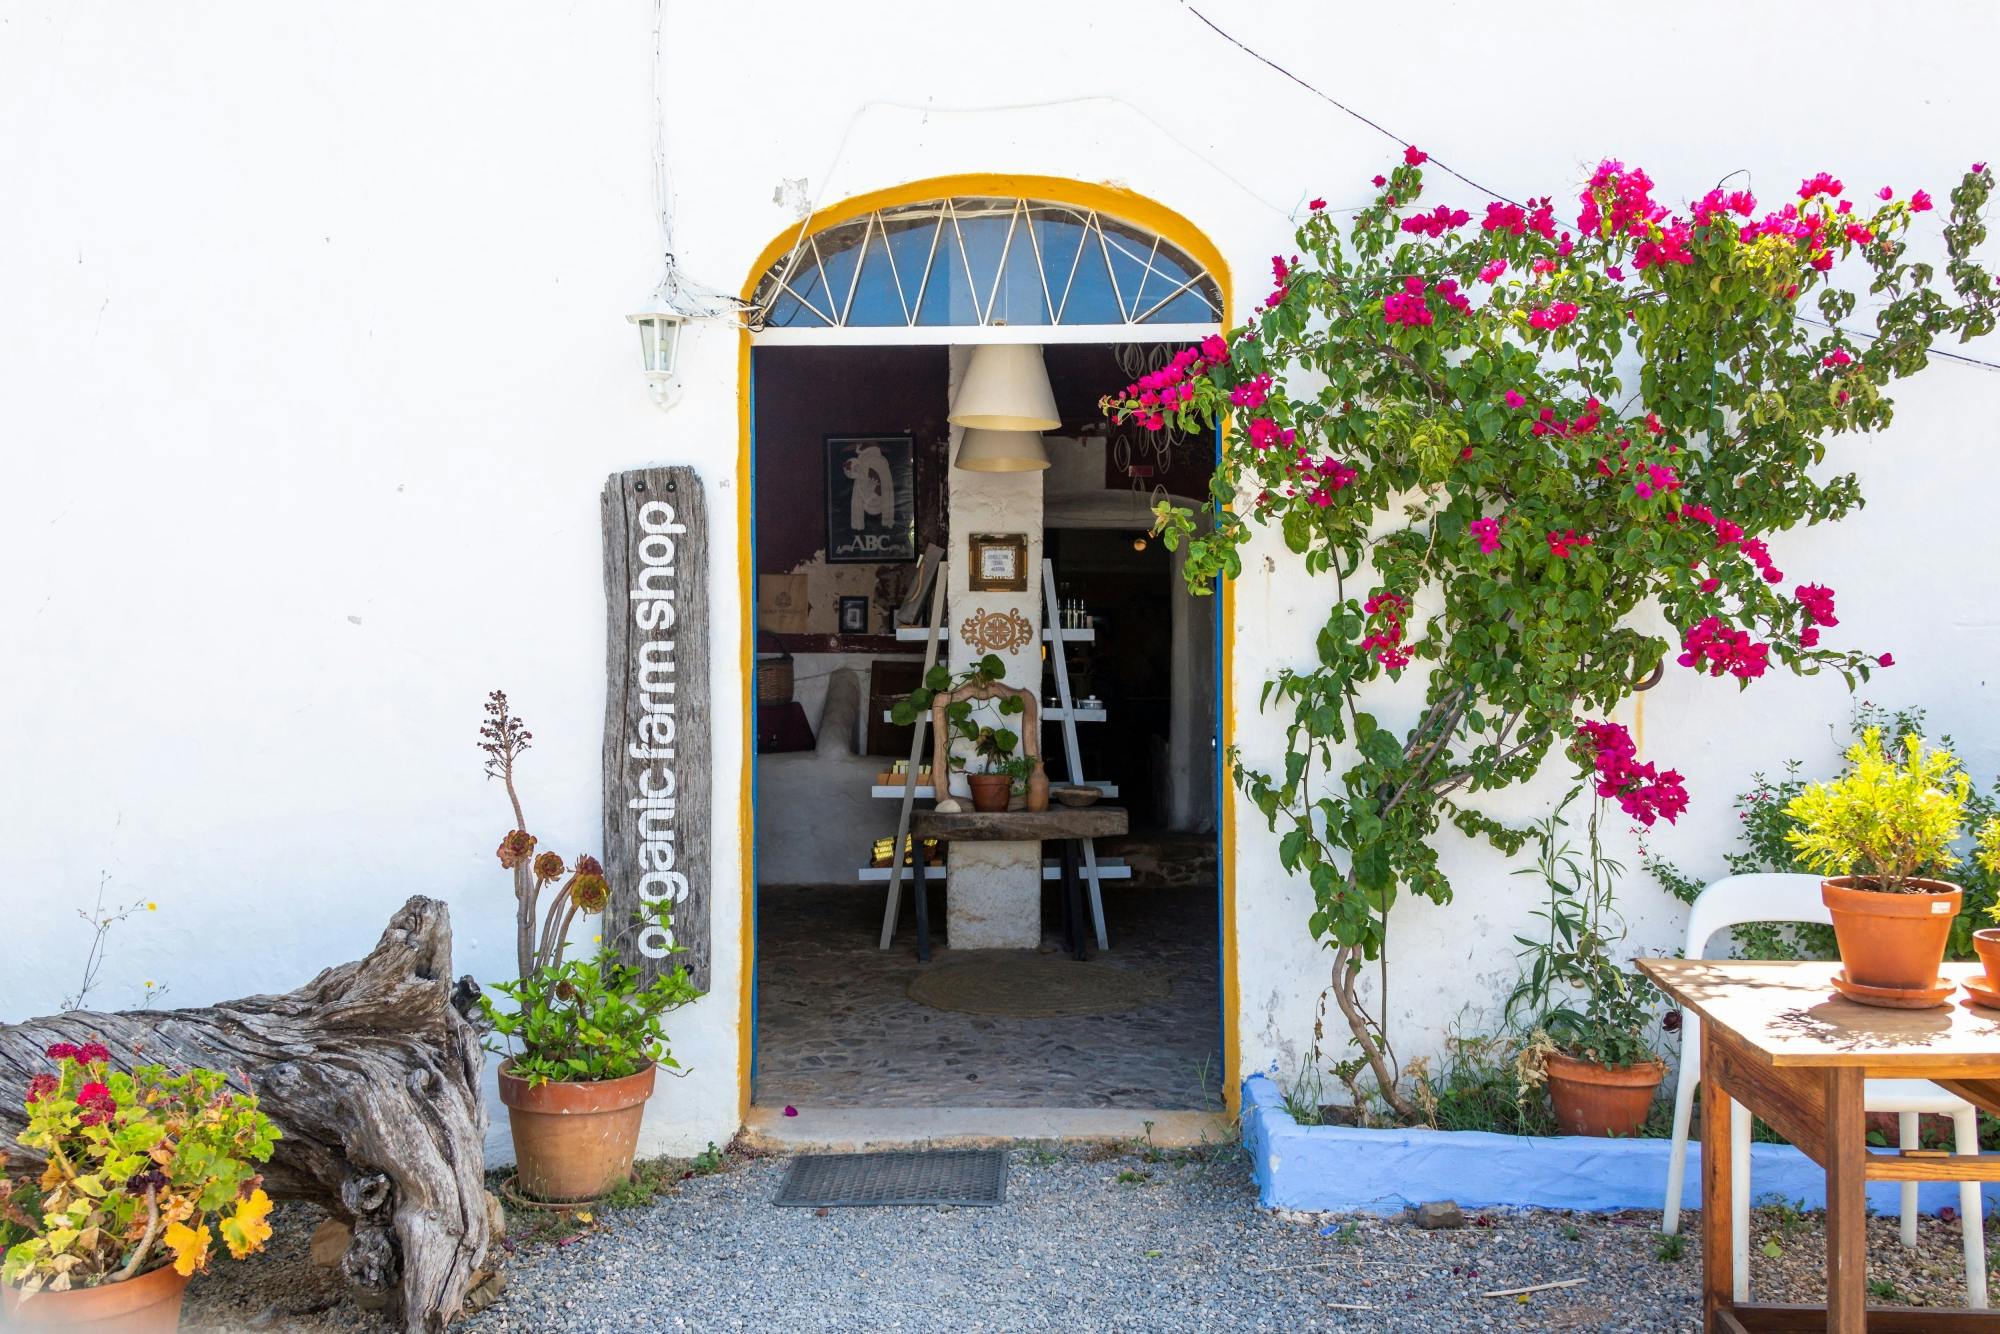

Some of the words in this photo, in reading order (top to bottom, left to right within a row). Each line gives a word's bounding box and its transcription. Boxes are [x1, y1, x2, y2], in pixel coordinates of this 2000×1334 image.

[630, 501, 686, 630] shop
[850, 535, 890, 551] ABC
[629, 641, 676, 758] farm
[630, 768, 689, 959] organic
